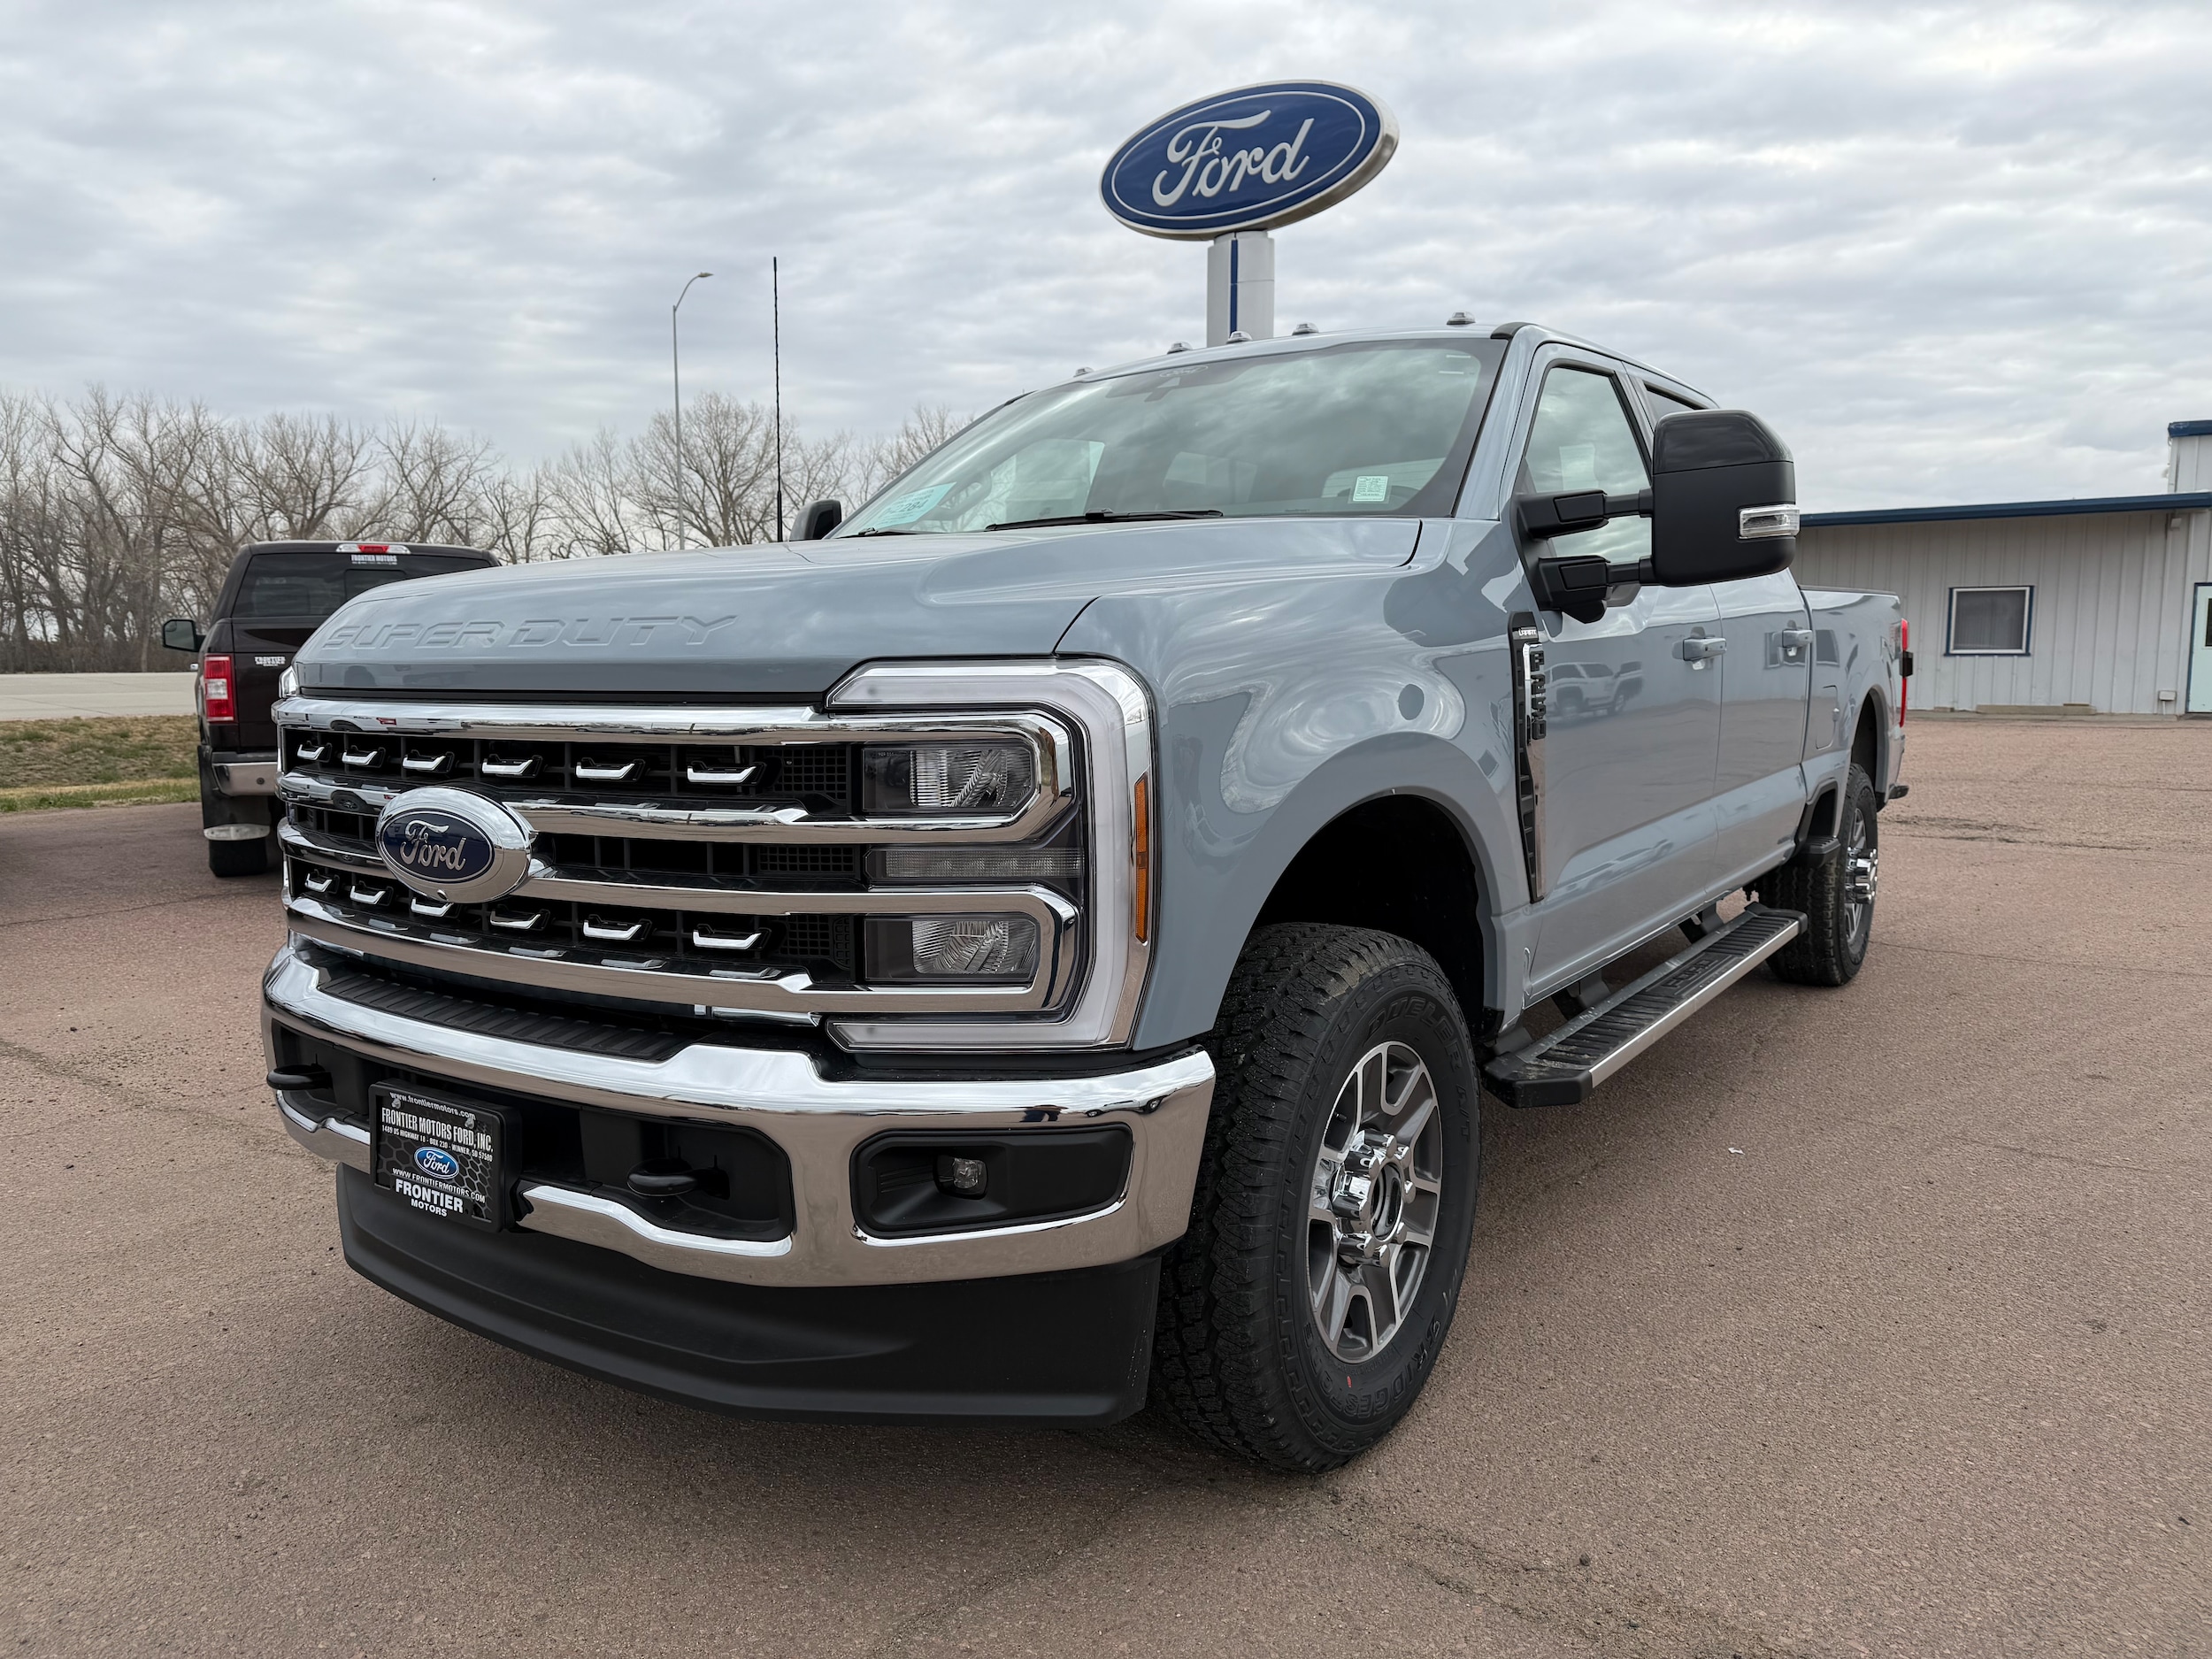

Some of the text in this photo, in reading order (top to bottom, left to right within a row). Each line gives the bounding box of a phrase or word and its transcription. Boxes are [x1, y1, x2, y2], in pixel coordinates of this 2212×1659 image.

[1152, 110, 1315, 207] Ford
[321, 615, 738, 649] SUPER DUTY
[400, 819, 467, 871] Ford
[382, 1108, 494, 1152] FRONTIER MOTORS FORD, INC.
[400, 1130, 419, 1141] HIGHWAY
[420, 1134, 426, 1143] 18
[430, 1138, 439, 1147] BOX
[423, 1151, 450, 1174] Ford
[396, 1179, 464, 1213] FRONTIER
[411, 1198, 448, 1217] MOTORS
